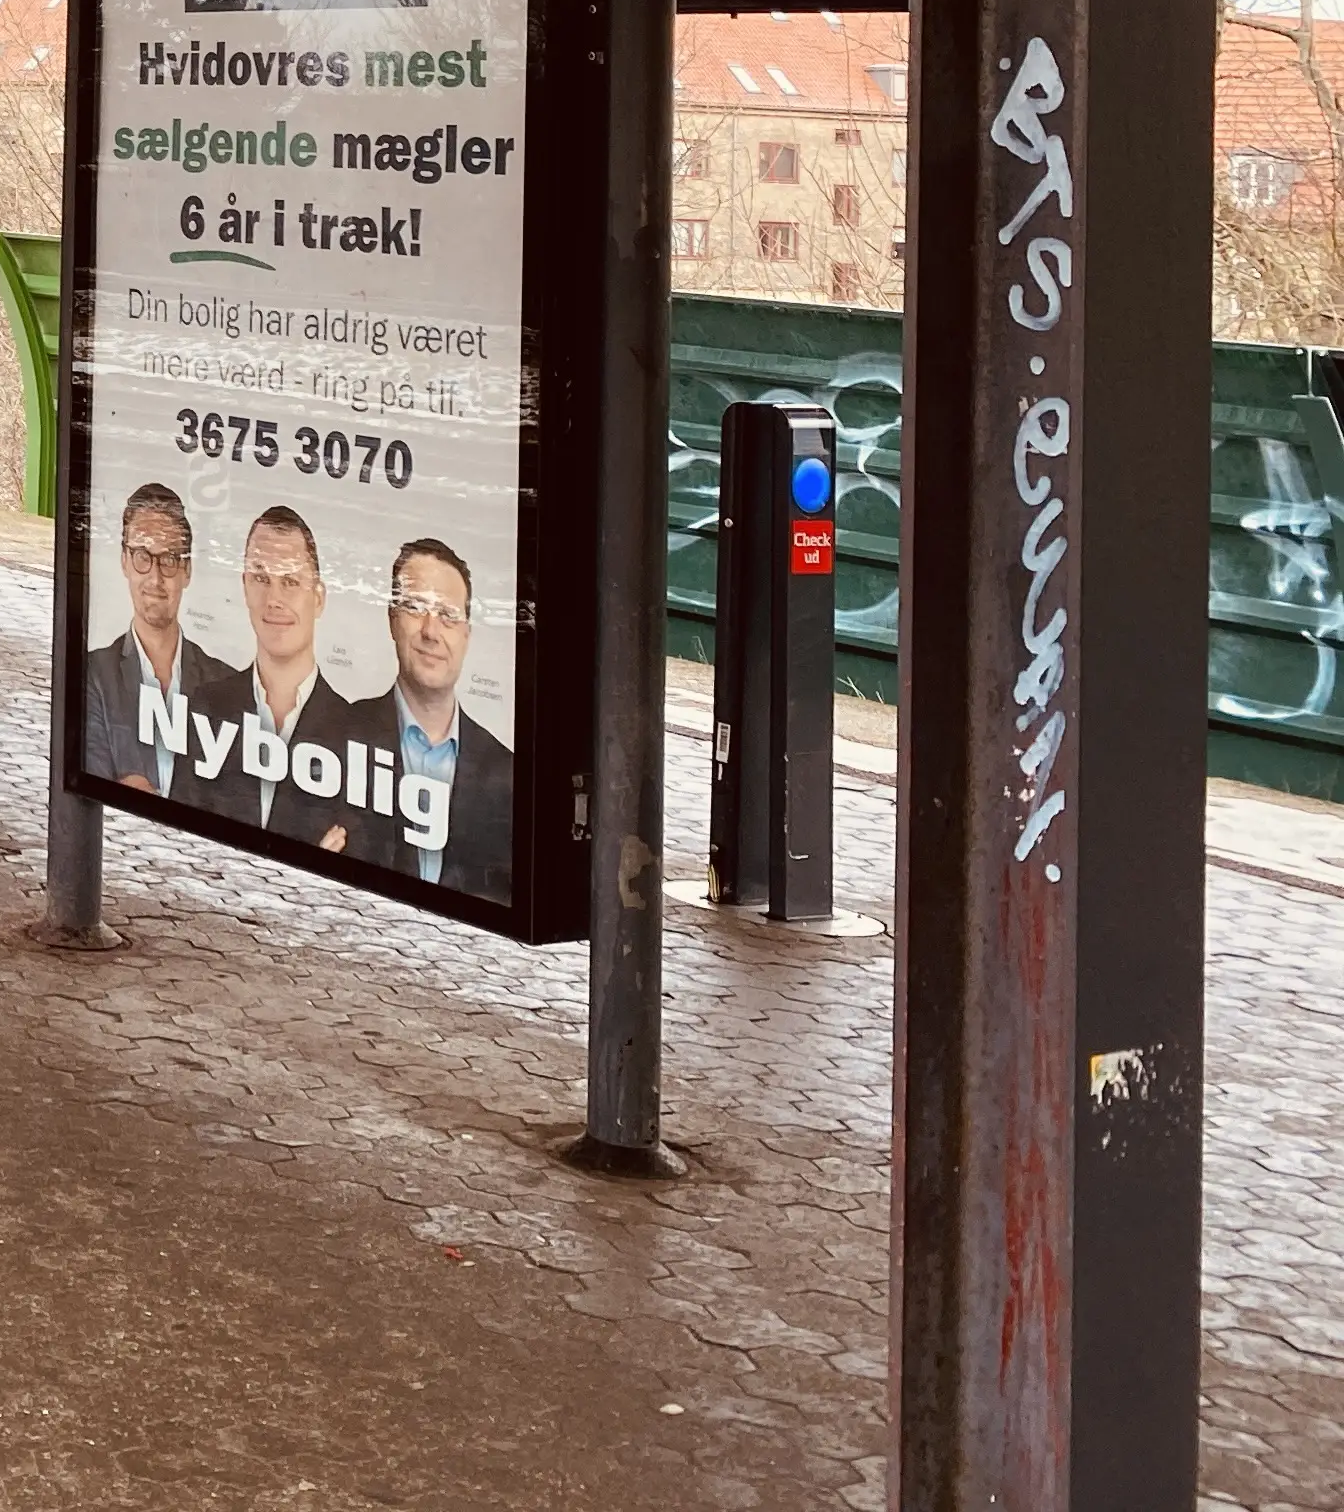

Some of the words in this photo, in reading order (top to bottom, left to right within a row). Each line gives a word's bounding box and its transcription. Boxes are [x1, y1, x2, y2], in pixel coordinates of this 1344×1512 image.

[139, 41, 351, 88] Hvidovres
[364, 39, 488, 88] mest
[112, 119, 317, 173] sælgende
[332, 124, 515, 184] mægler
[179, 195, 205, 240] 6
[217, 191, 261, 245] år
[273, 199, 285, 246] i
[298, 202, 423, 257] træk!
[127, 288, 169, 324] Din
[178, 292, 241, 339] bolig
[248, 299, 292, 338] har
[304, 307, 390, 355] aldrig
[397, 322, 489, 360] været
[142, 350, 210, 379] mere
[216, 360, 285, 392] værd
[312, 365, 368, 413] ring
[380, 372, 414, 416] på
[175, 407, 280, 468] 3675
[293, 426, 413, 490] 3070
[793, 532, 832, 547] Check
[803, 550, 820, 564] ud
[137, 682, 450, 851] Nybolig
